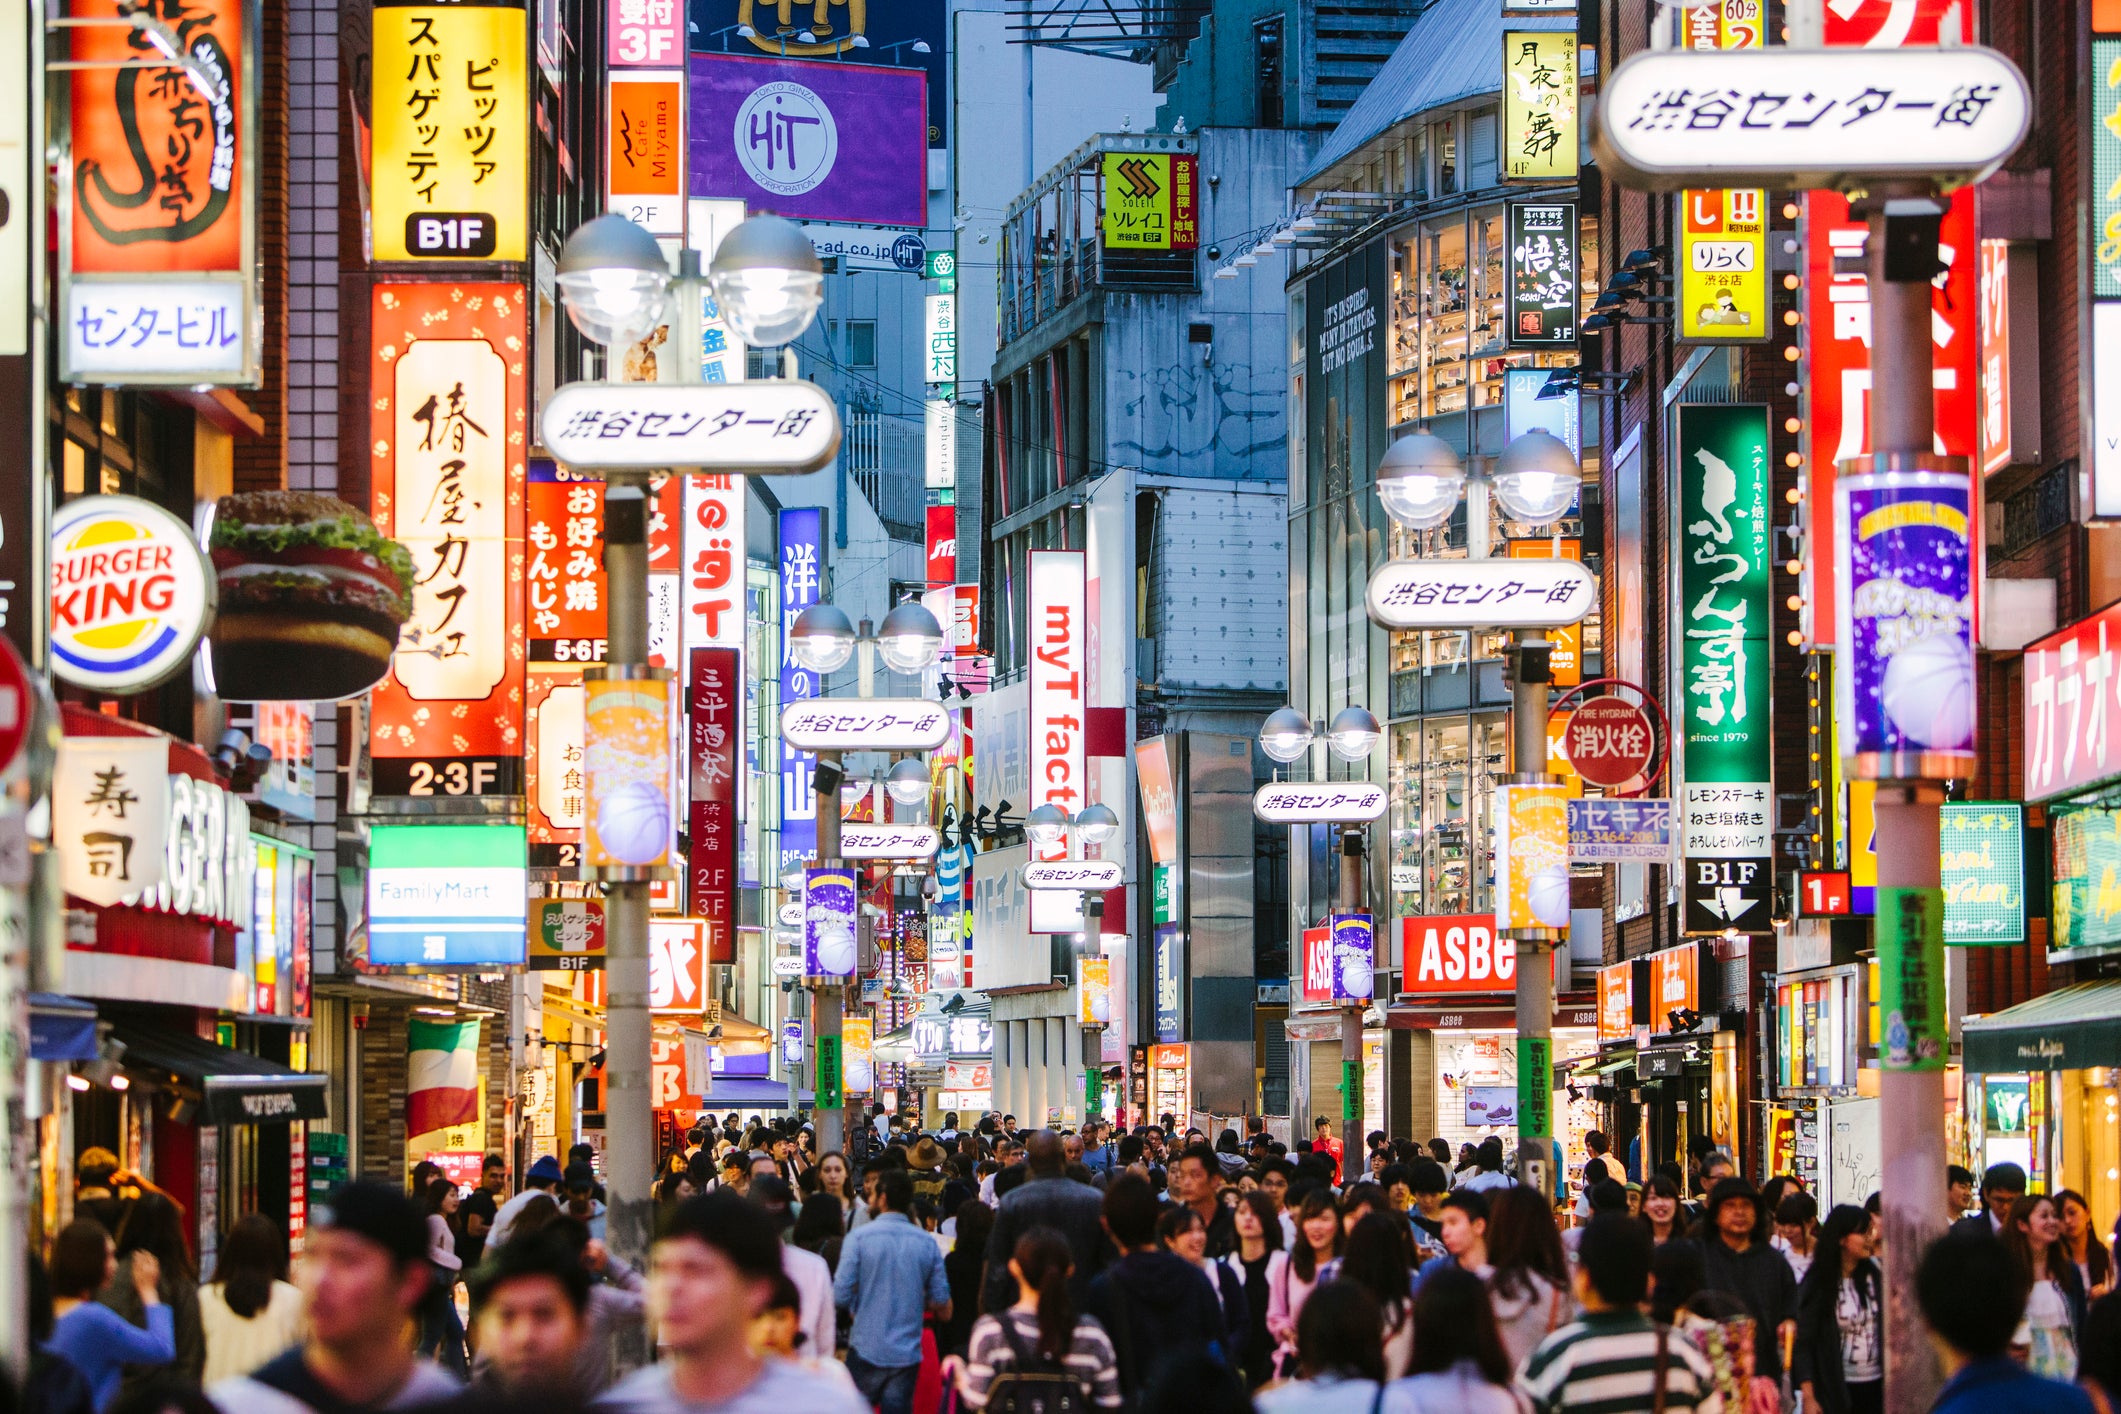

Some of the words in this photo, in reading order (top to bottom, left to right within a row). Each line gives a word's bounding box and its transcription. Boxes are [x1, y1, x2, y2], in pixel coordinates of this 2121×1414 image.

[618, 27, 674, 62] 3F
[754, 83, 784, 99] TOKYO
[789, 84, 815, 103] GINZA
[1514, 42, 1561, 167] 月夜の舞
[407, 17, 440, 203] スパゲッティ
[1629, 85, 2000, 130] 渋谷センター街
[464, 58, 499, 185] ピッツァ
[635, 119, 648, 157] Cafe
[652, 100, 667, 178] Miyama
[1511, 162, 1530, 175] 4F
[755, 174, 816, 192] CORPORATION
[1177, 161, 1190, 219] お部屋探し
[632, 206, 658, 223] 2F
[1122, 199, 1155, 208] SOLEIL
[1113, 212, 1165, 229] ソレイユ
[1174, 220, 1194, 231] 地域
[418, 220, 483, 249] B1F
[1117, 233, 1141, 241] 渋谷店
[1144, 233, 1160, 242] 6F
[1174, 233, 1194, 243] No.1
[1700, 247, 1746, 268] りらく
[1515, 235, 1572, 310] 悟空
[1704, 275, 1742, 285] 渋谷店
[78, 306, 238, 350] センタービル
[1554, 328, 1572, 339] 3F
[1335, 346, 1345, 368] NO
[1515, 376, 1537, 391] 2F
[560, 409, 820, 439] 渋谷センター街
[1752, 444, 1766, 570] ステーキと焙煎カレー
[565, 486, 598, 612] お好み焼
[51, 546, 172, 588] BURGER
[528, 522, 560, 634] もんじゃ
[51, 575, 176, 632] KING
[1382, 580, 1582, 605] 渋谷センター街
[1037, 605, 1079, 700] myT
[1579, 709, 1597, 720] FIRE
[1599, 708, 1636, 720] HYDRANT
[2030, 620, 2121, 789] カラオ
[790, 714, 941, 732] 渋谷センター街
[1573, 724, 1646, 758] 消火栓
[1690, 732, 1719, 743] since
[1723, 732, 1748, 743] 1979
[562, 743, 584, 818] お食事
[1262, 793, 1381, 809] 渋谷センター街
[1689, 789, 1765, 803] レモンステーキ
[83, 764, 138, 881] 寿司
[702, 803, 721, 851] 渋谷店
[1581, 802, 1670, 831] セキネ
[1690, 811, 1764, 827] ねぎ塩焼き
[841, 835, 932, 848] 谷センター街
[1689, 835, 1765, 849] おろししそハンバーグ
[698, 868, 725, 886] 2F
[1029, 869, 1116, 881] 渋谷センター街
[1697, 862, 1758, 886] B1F
[381, 882, 489, 903] FamilyMart
[1807, 879, 1841, 911] 1F
[698, 899, 725, 915] 3F
[423, 936, 446, 961] 酒
[559, 956, 589, 970] B1F
[1440, 1014, 1463, 1027] ASBee
